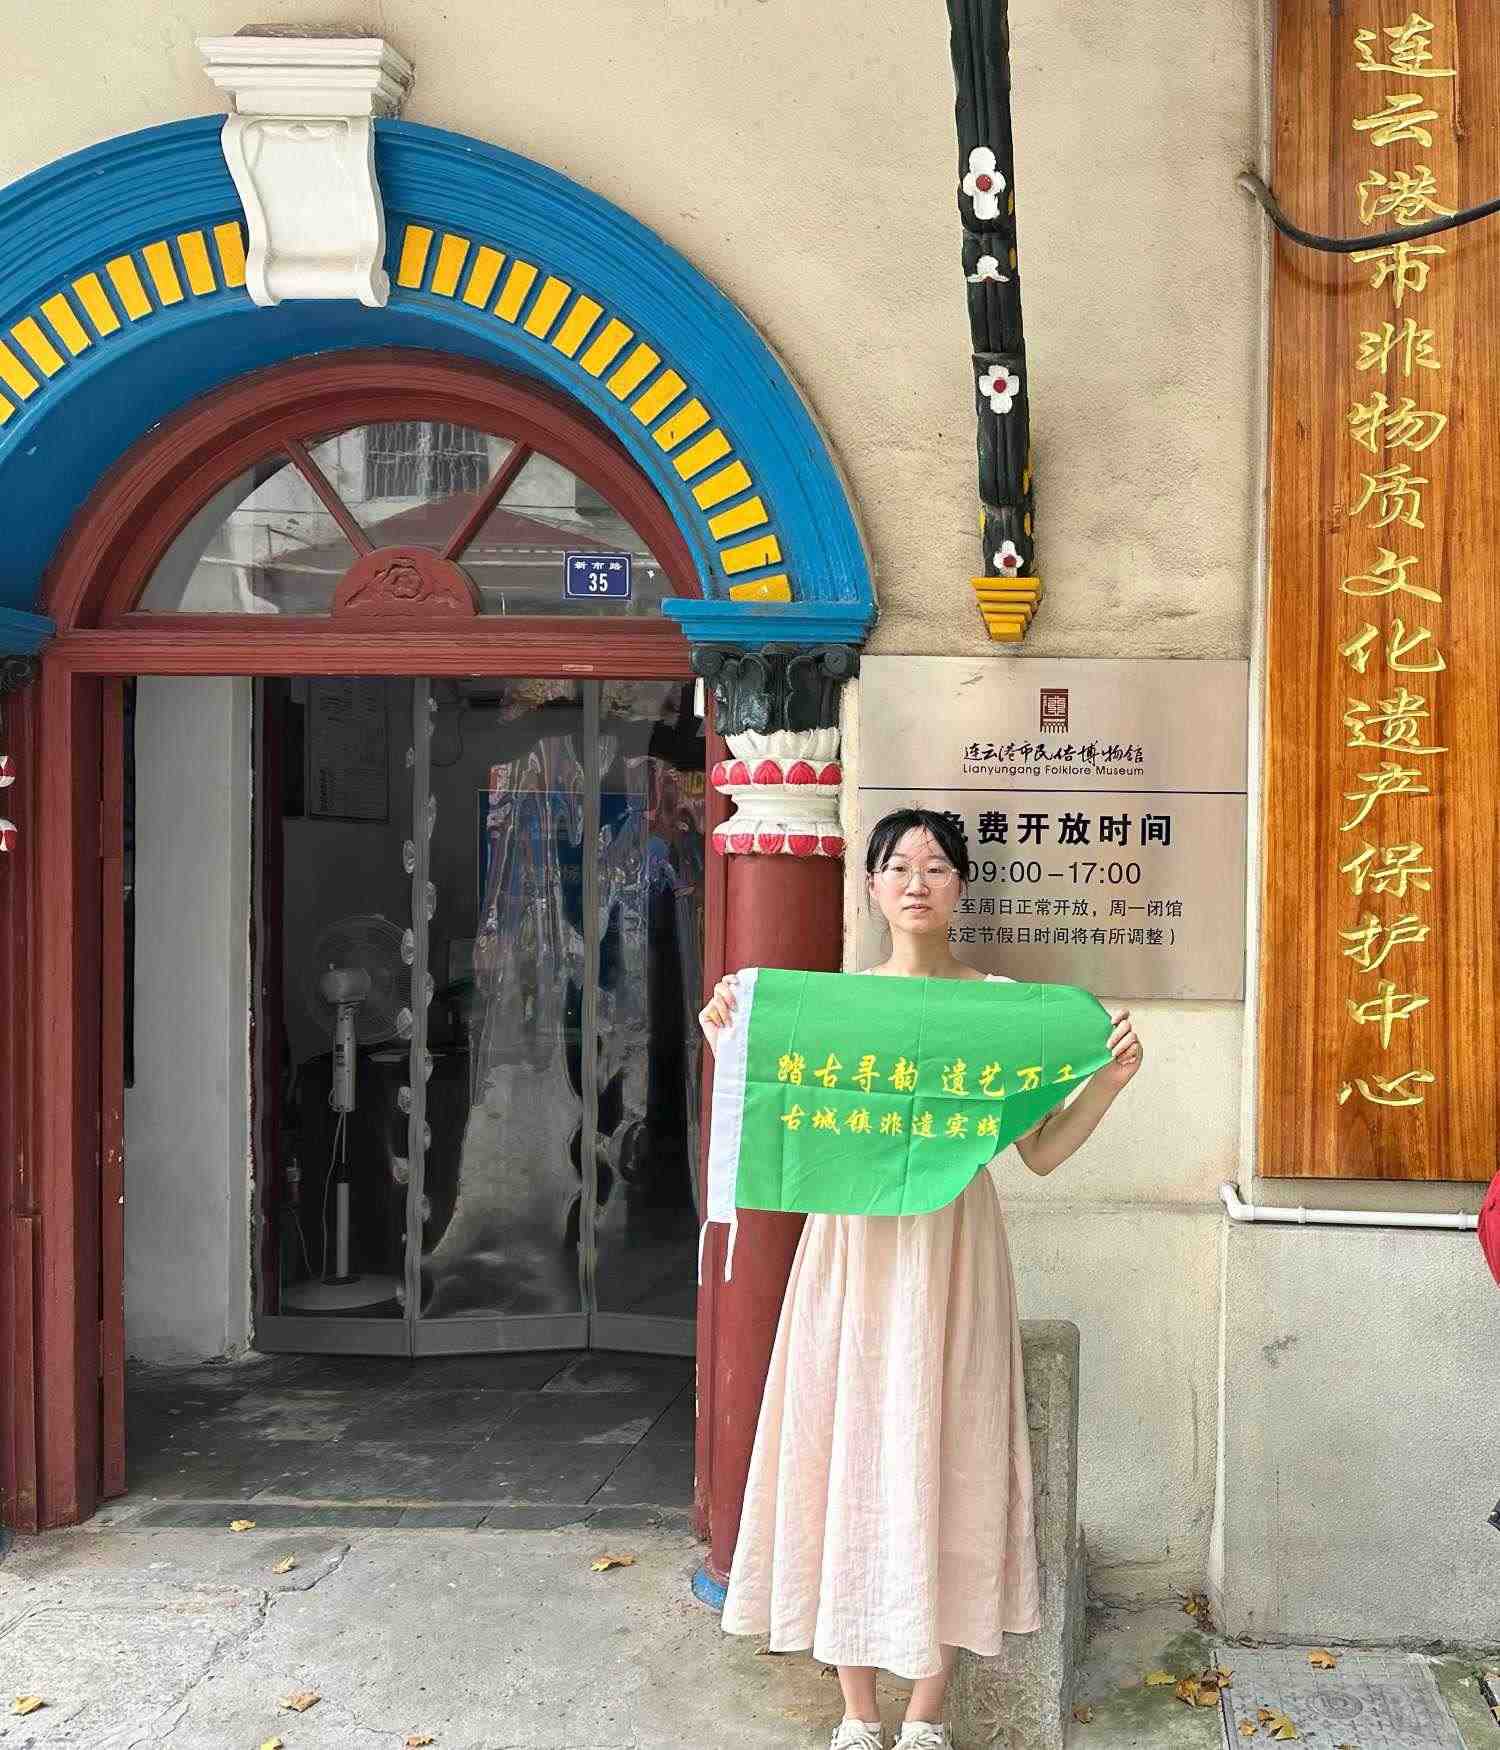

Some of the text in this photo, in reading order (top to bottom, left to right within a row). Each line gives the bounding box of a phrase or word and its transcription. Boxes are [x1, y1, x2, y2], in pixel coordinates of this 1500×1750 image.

[588, 572, 608, 592] 35
[962, 763, 1145, 777] Lianyungang Folklore Museum
[953, 898, 1183, 918] 至周日正常开放，周一闭馆
[777, 1052, 919, 1096] 踏古寻韵
